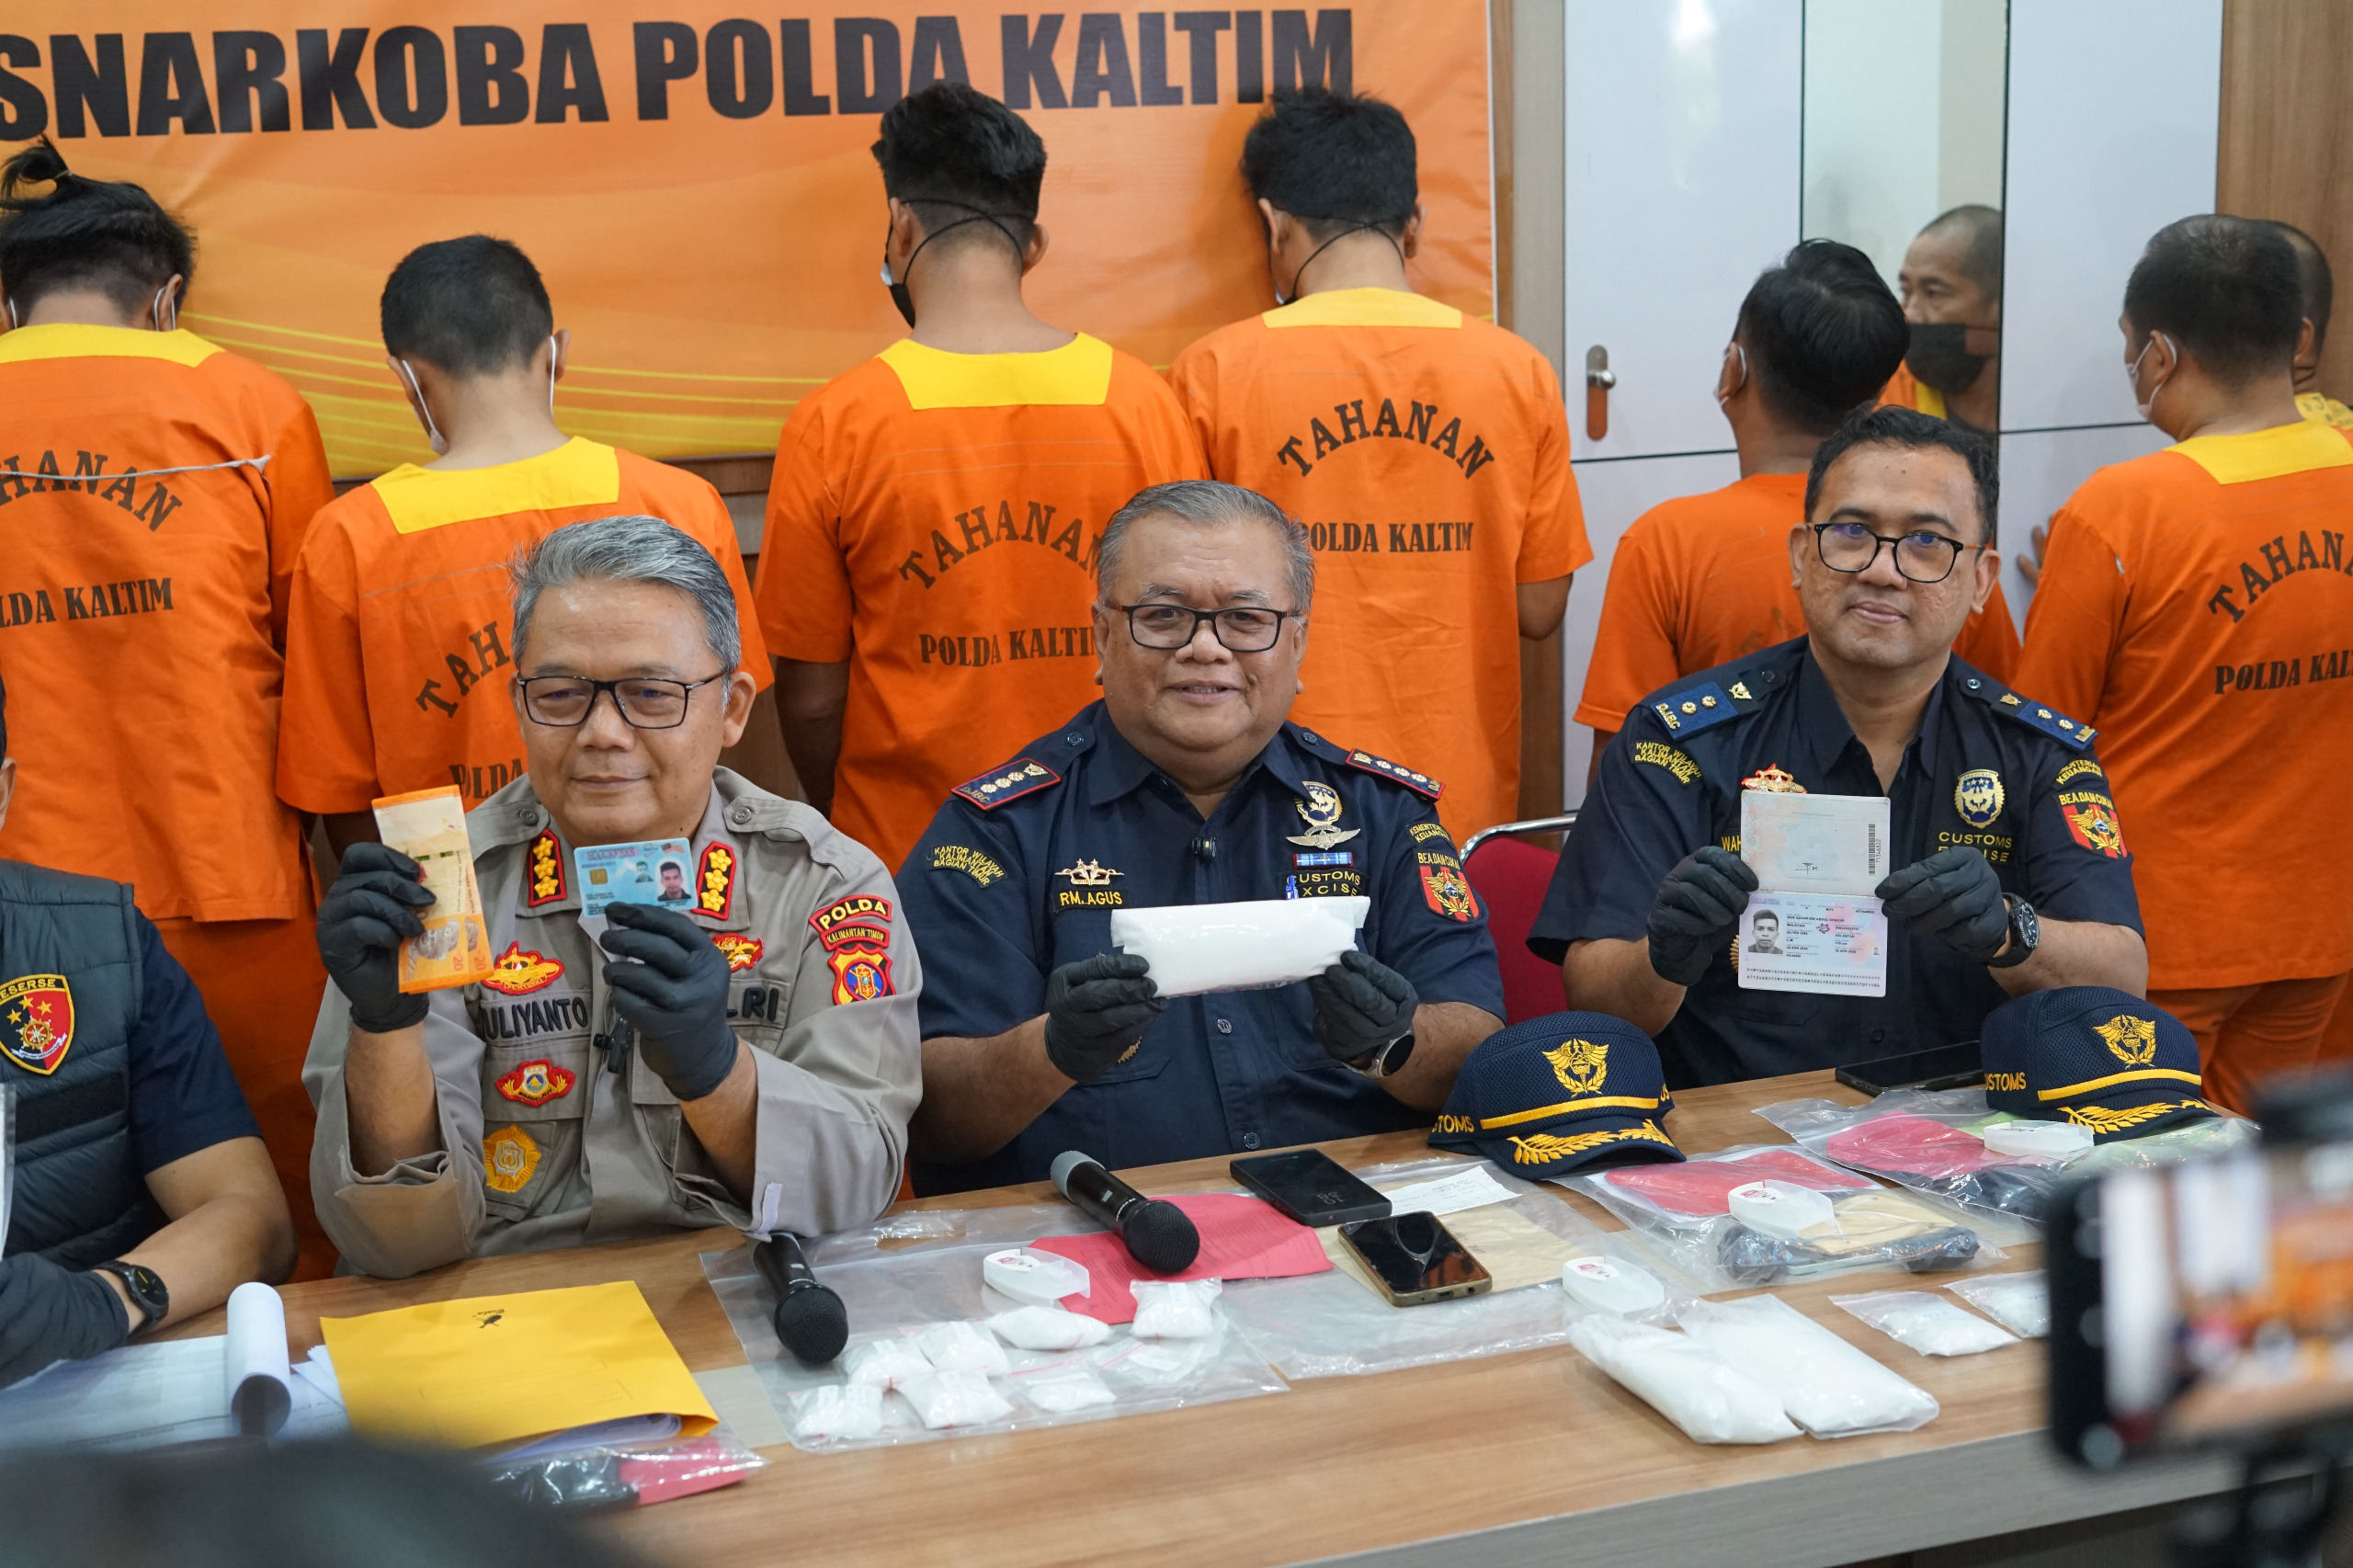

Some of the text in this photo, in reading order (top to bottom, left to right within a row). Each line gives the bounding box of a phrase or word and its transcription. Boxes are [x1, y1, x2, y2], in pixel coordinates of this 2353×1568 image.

[632, 16, 972, 120] POLDA
[1001, 8, 1353, 110] KALTIM
[1277, 398, 1495, 479] TAHANAN
[1389, 522, 1474, 552] KALTIM
[2208, 529, 2353, 623] TAHAN
[63, 577, 174, 620] KALTIM
[919, 633, 1002, 667] POLDA
[2214, 649, 2353, 694] POLDA KAL
[1636, 742, 1671, 755] KANTOR
[1641, 746, 1694, 778] KALIMANTAN
[1635, 754, 1690, 784] BAGIAN TIMUR
[2056, 766, 2103, 785] KEUANGAN
[2059, 792, 2079, 805] BEA
[1938, 832, 2012, 848] CUSTOMS
[934, 846, 1005, 877] KANTOR WILAYAH
[934, 860, 990, 885] BAGIAN TIMUR
[940, 851, 993, 877] KALIMANTAN
[1086, 892, 1123, 905] AGUS
[1302, 884, 1358, 897] XCISE
[819, 899, 887, 929] POLDA
[826, 927, 884, 944] KALIMANTAN TIMUR
[474, 956, 486, 971] 20
[0, 979, 56, 1001] ESERSE
